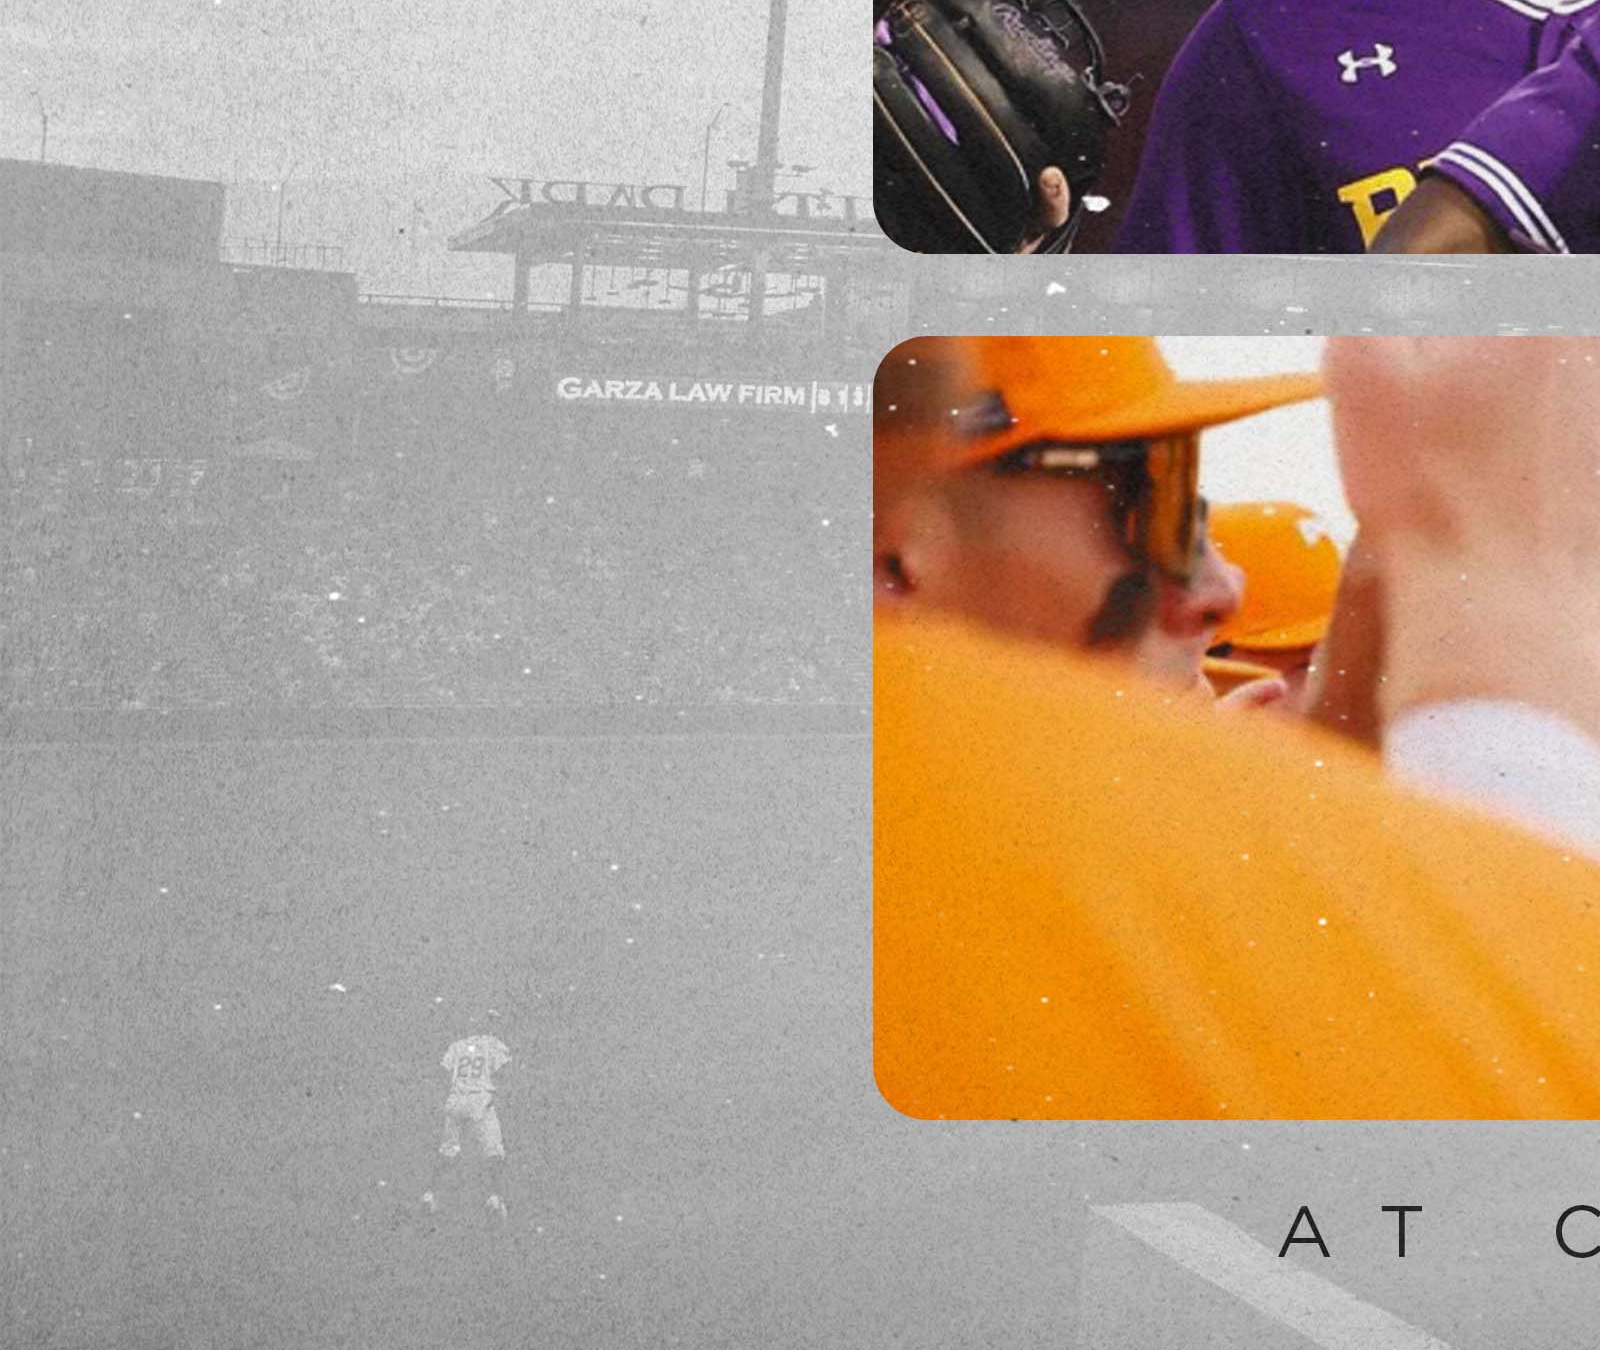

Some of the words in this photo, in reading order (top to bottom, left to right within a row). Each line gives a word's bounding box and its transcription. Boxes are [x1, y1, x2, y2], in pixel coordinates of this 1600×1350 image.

[556, 376, 663, 402] GARZA
[669, 382, 733, 404] LAW
[738, 384, 806, 407] FIRM
[459, 1056, 485, 1079] 29
